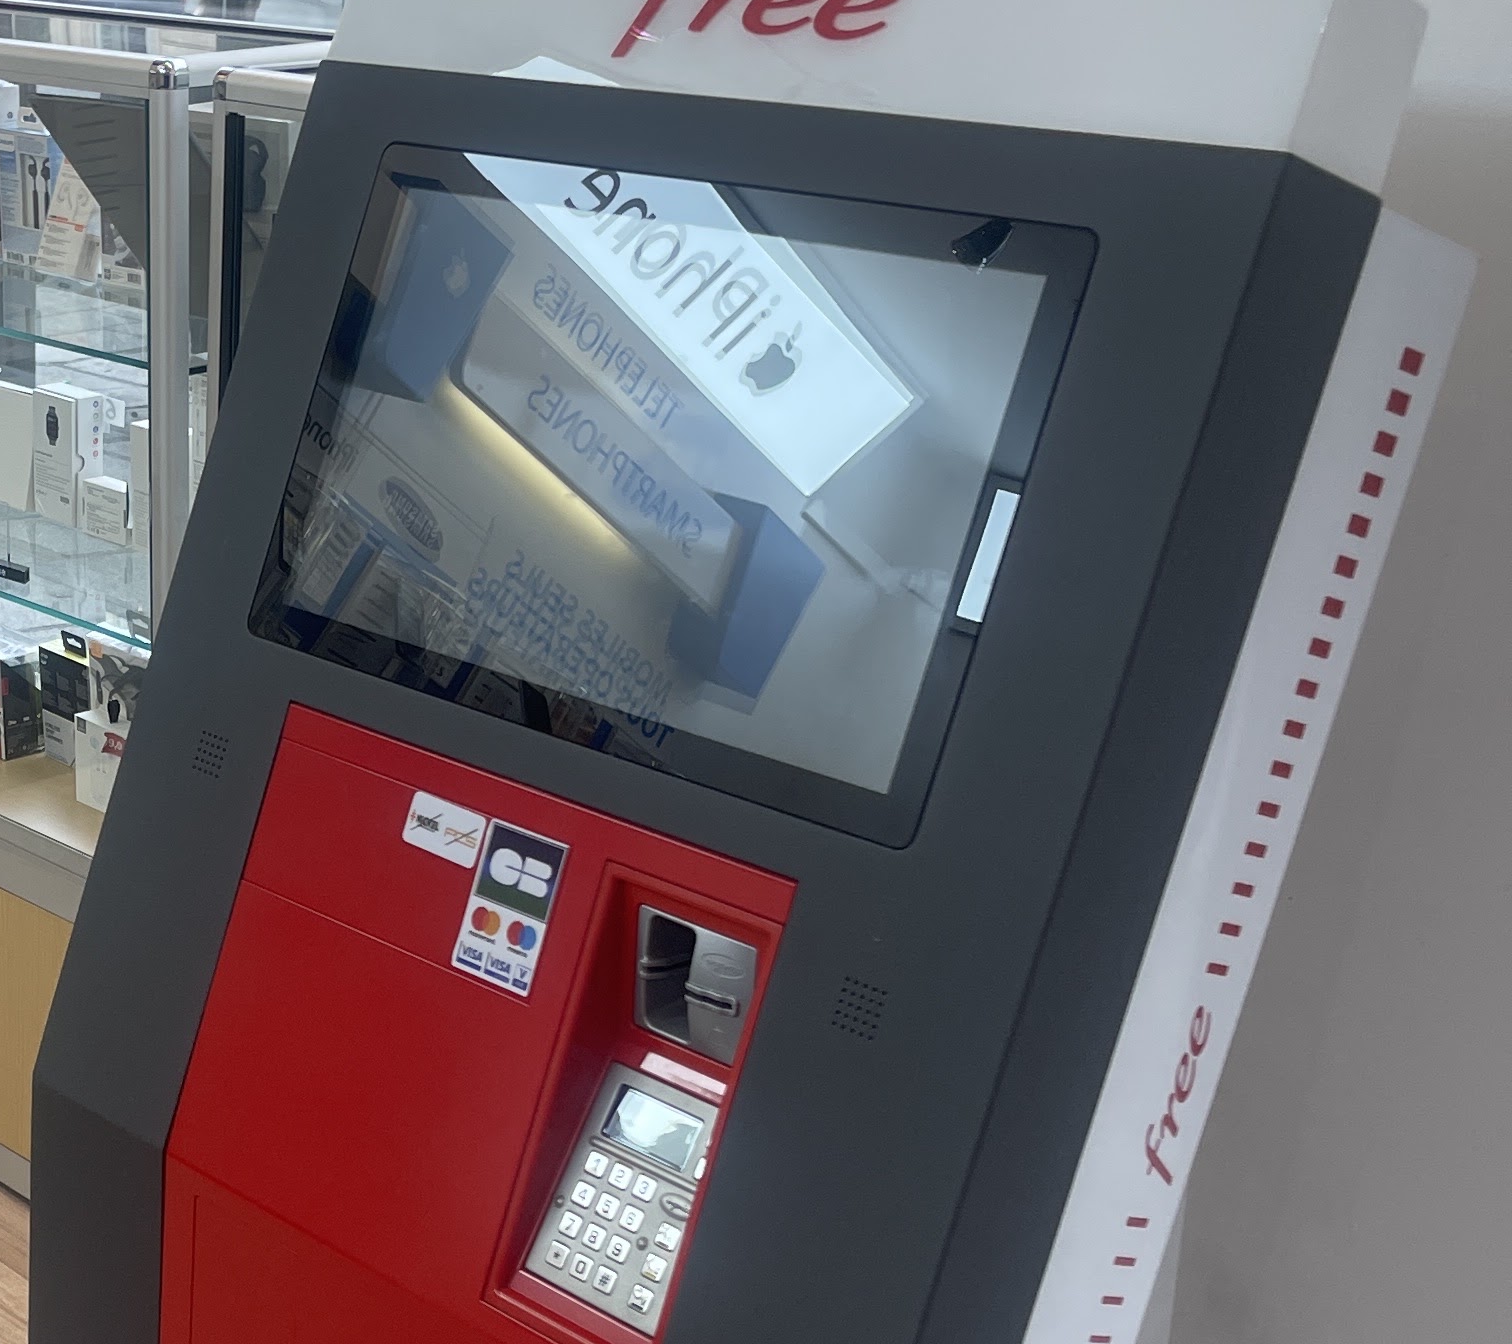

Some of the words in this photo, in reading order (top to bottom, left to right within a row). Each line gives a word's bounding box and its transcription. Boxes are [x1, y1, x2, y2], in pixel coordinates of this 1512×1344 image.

[489, 847, 553, 898] CB
[461, 945, 484, 963] VISA
[489, 956, 513, 974] VISA
[1144, 1005, 1212, 1186] free
[613, 1168, 626, 1184] 2
[638, 1180, 650, 1195] 3
[577, 1187, 589, 1202] 4
[601, 1199, 614, 1214] 5
[625, 1211, 637, 1226] 6
[564, 1217, 576, 1232] 7
[587, 1229, 599, 1245] 8
[611, 1242, 623, 1257] 9
[574, 1260, 587, 1275] 0
